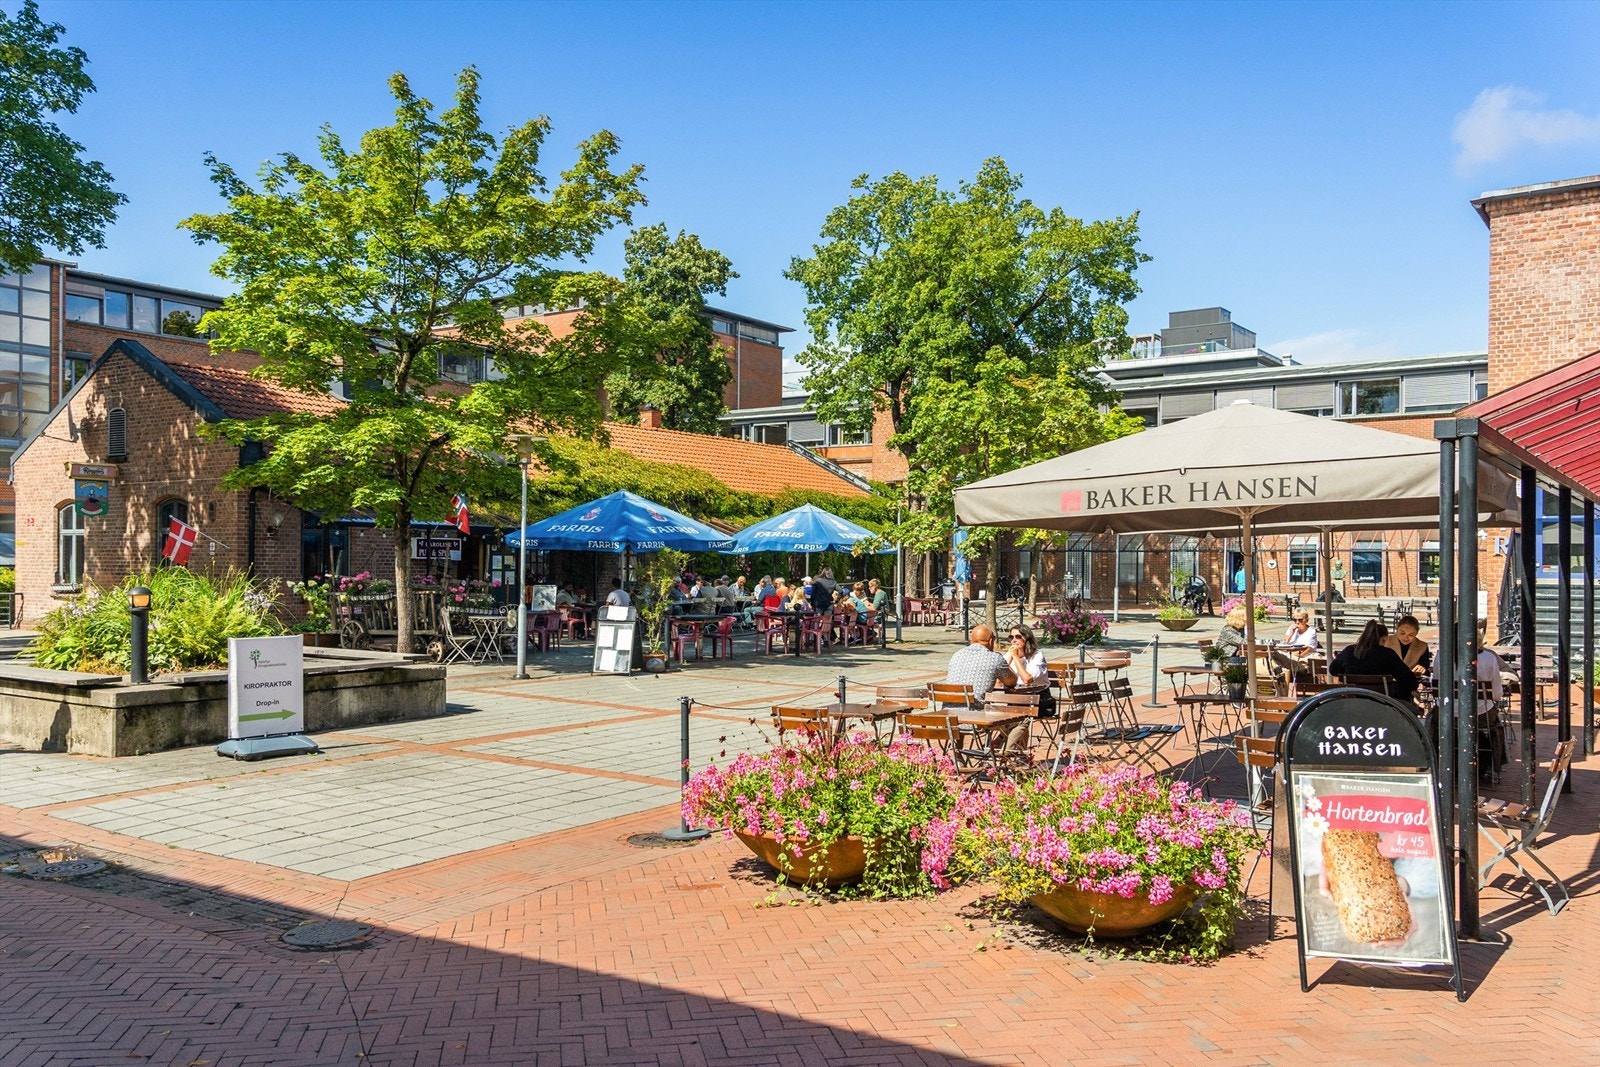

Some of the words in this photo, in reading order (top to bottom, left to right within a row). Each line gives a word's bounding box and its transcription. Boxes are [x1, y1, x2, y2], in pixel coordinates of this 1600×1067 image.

[1085, 484, 1176, 510] BAKER
[1188, 475, 1319, 503] HANSEN
[547, 525, 604, 533] FARRIS
[588, 540, 620, 550] FARRIS
[637, 541, 666, 550] FARRIS
[244, 681, 291, 689] KIROPRAKTOR
[1318, 741, 1402, 757] Hansen
[1326, 800, 1428, 826] Hortenbrød
[1397, 833, 1408, 847] kr
[1410, 835, 1425, 848] 45
